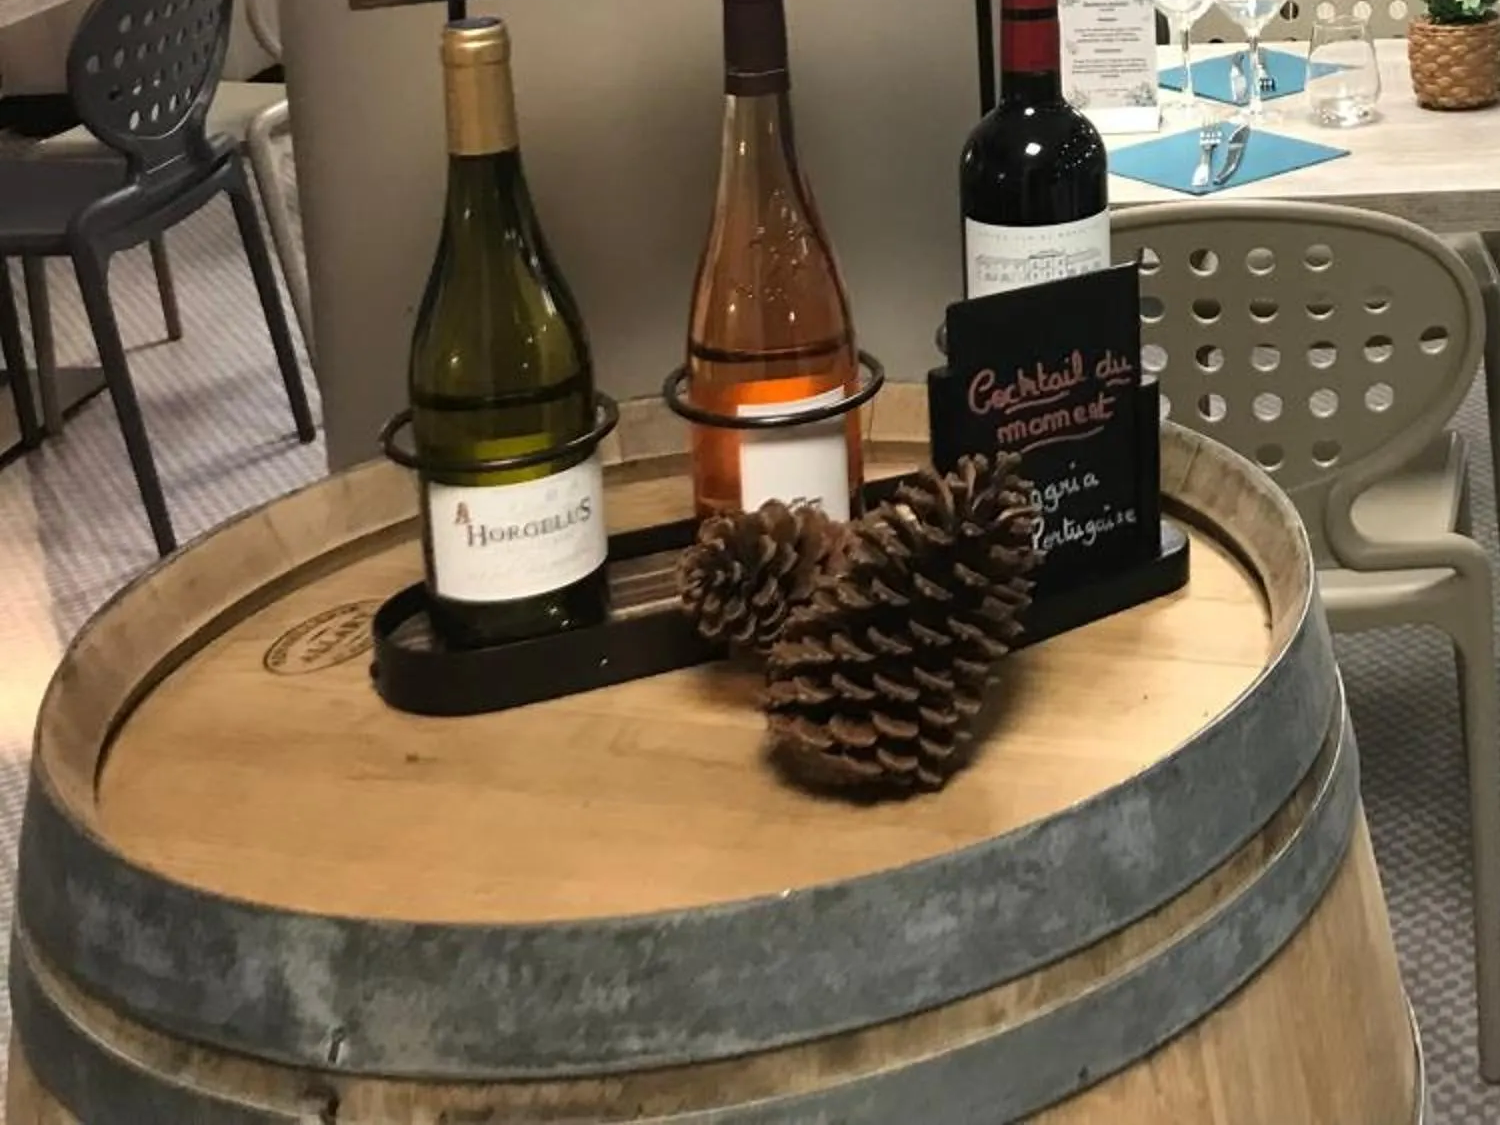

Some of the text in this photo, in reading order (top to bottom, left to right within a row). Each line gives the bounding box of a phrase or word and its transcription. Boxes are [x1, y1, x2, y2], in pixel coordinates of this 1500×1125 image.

[968, 348, 1133, 414] Cocktail du
[997, 393, 1115, 443] moment
